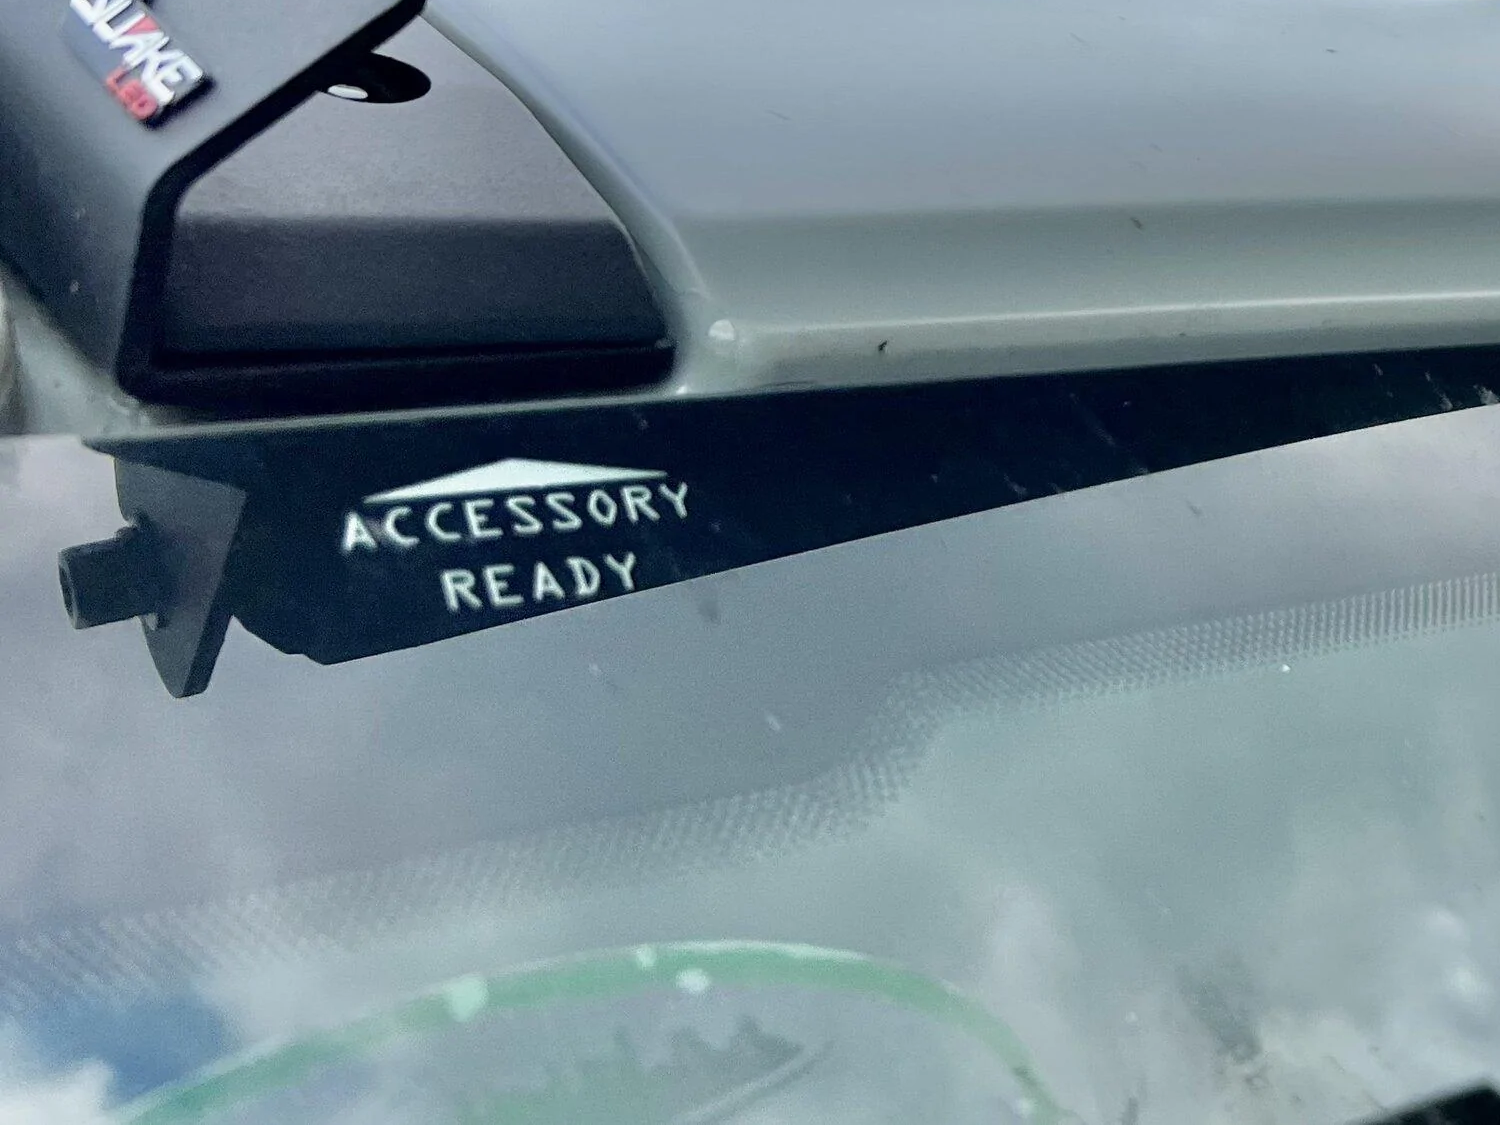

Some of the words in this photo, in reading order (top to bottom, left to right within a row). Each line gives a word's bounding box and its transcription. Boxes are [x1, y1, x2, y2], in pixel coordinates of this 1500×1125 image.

[105, 65, 159, 121] LED
[340, 481, 689, 554] ACCESSORY
[440, 551, 636, 613] READY
